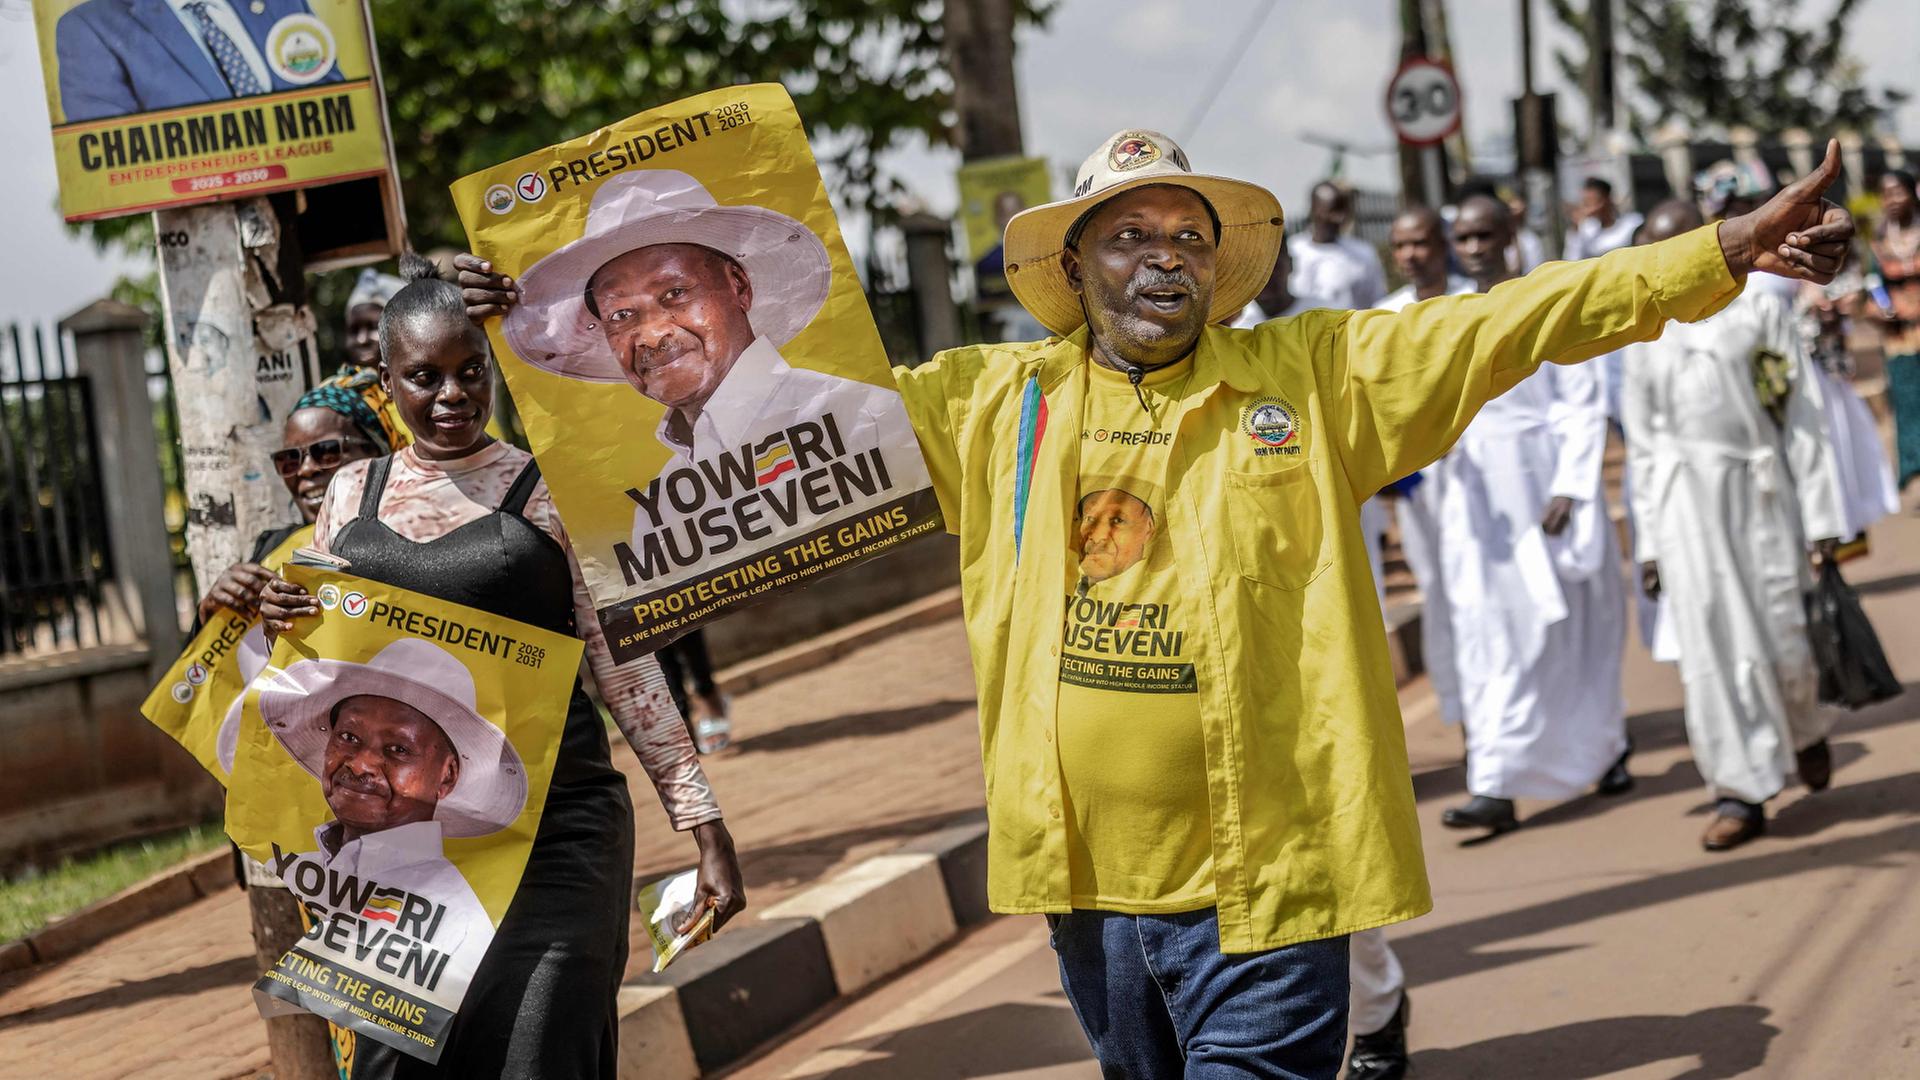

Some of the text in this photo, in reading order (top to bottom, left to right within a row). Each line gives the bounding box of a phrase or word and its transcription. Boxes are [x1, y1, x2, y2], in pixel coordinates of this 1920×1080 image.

[79, 94, 356, 172] CHAIRMAN NRM
[714, 101, 749, 120] 2026
[719, 112, 752, 131] 2031
[1397, 81, 1453, 123] 30
[109, 139, 334, 186] ENTREPRENEURS LEAGUE
[235, 168, 269, 184] 2030
[549, 111, 711, 192] PRESIDENT
[624, 412, 847, 528] YOWERI
[1284, 445, 1301, 455] PARTY
[612, 447, 893, 587] MUSEVENI
[619, 520, 936, 648] AS WE MAKE A QUALITATIVE LEAP INTO HIGH MIDDLE INCOME STATUS
[632, 505, 909, 625] PROTECTING THE GAINS
[369, 601, 545, 659] PRESIDENT 2026
[1064, 594, 1169, 629] YOWERI
[515, 653, 542, 669] 2031
[1062, 657, 1180, 680] ECTING THE GAINS
[271, 842, 447, 943] YOWERI
[296, 894, 450, 992] SEVENI
[276, 951, 427, 1026] CTING THE GAINS
[292, 979, 312, 994] LEAP
[312, 988, 331, 1002] INTO
[330, 996, 350, 1010] HIGH
[349, 1004, 378, 1023] MIDDLE
[377, 1016, 409, 1036] INCOME
[407, 1028, 436, 1048] STATUS
